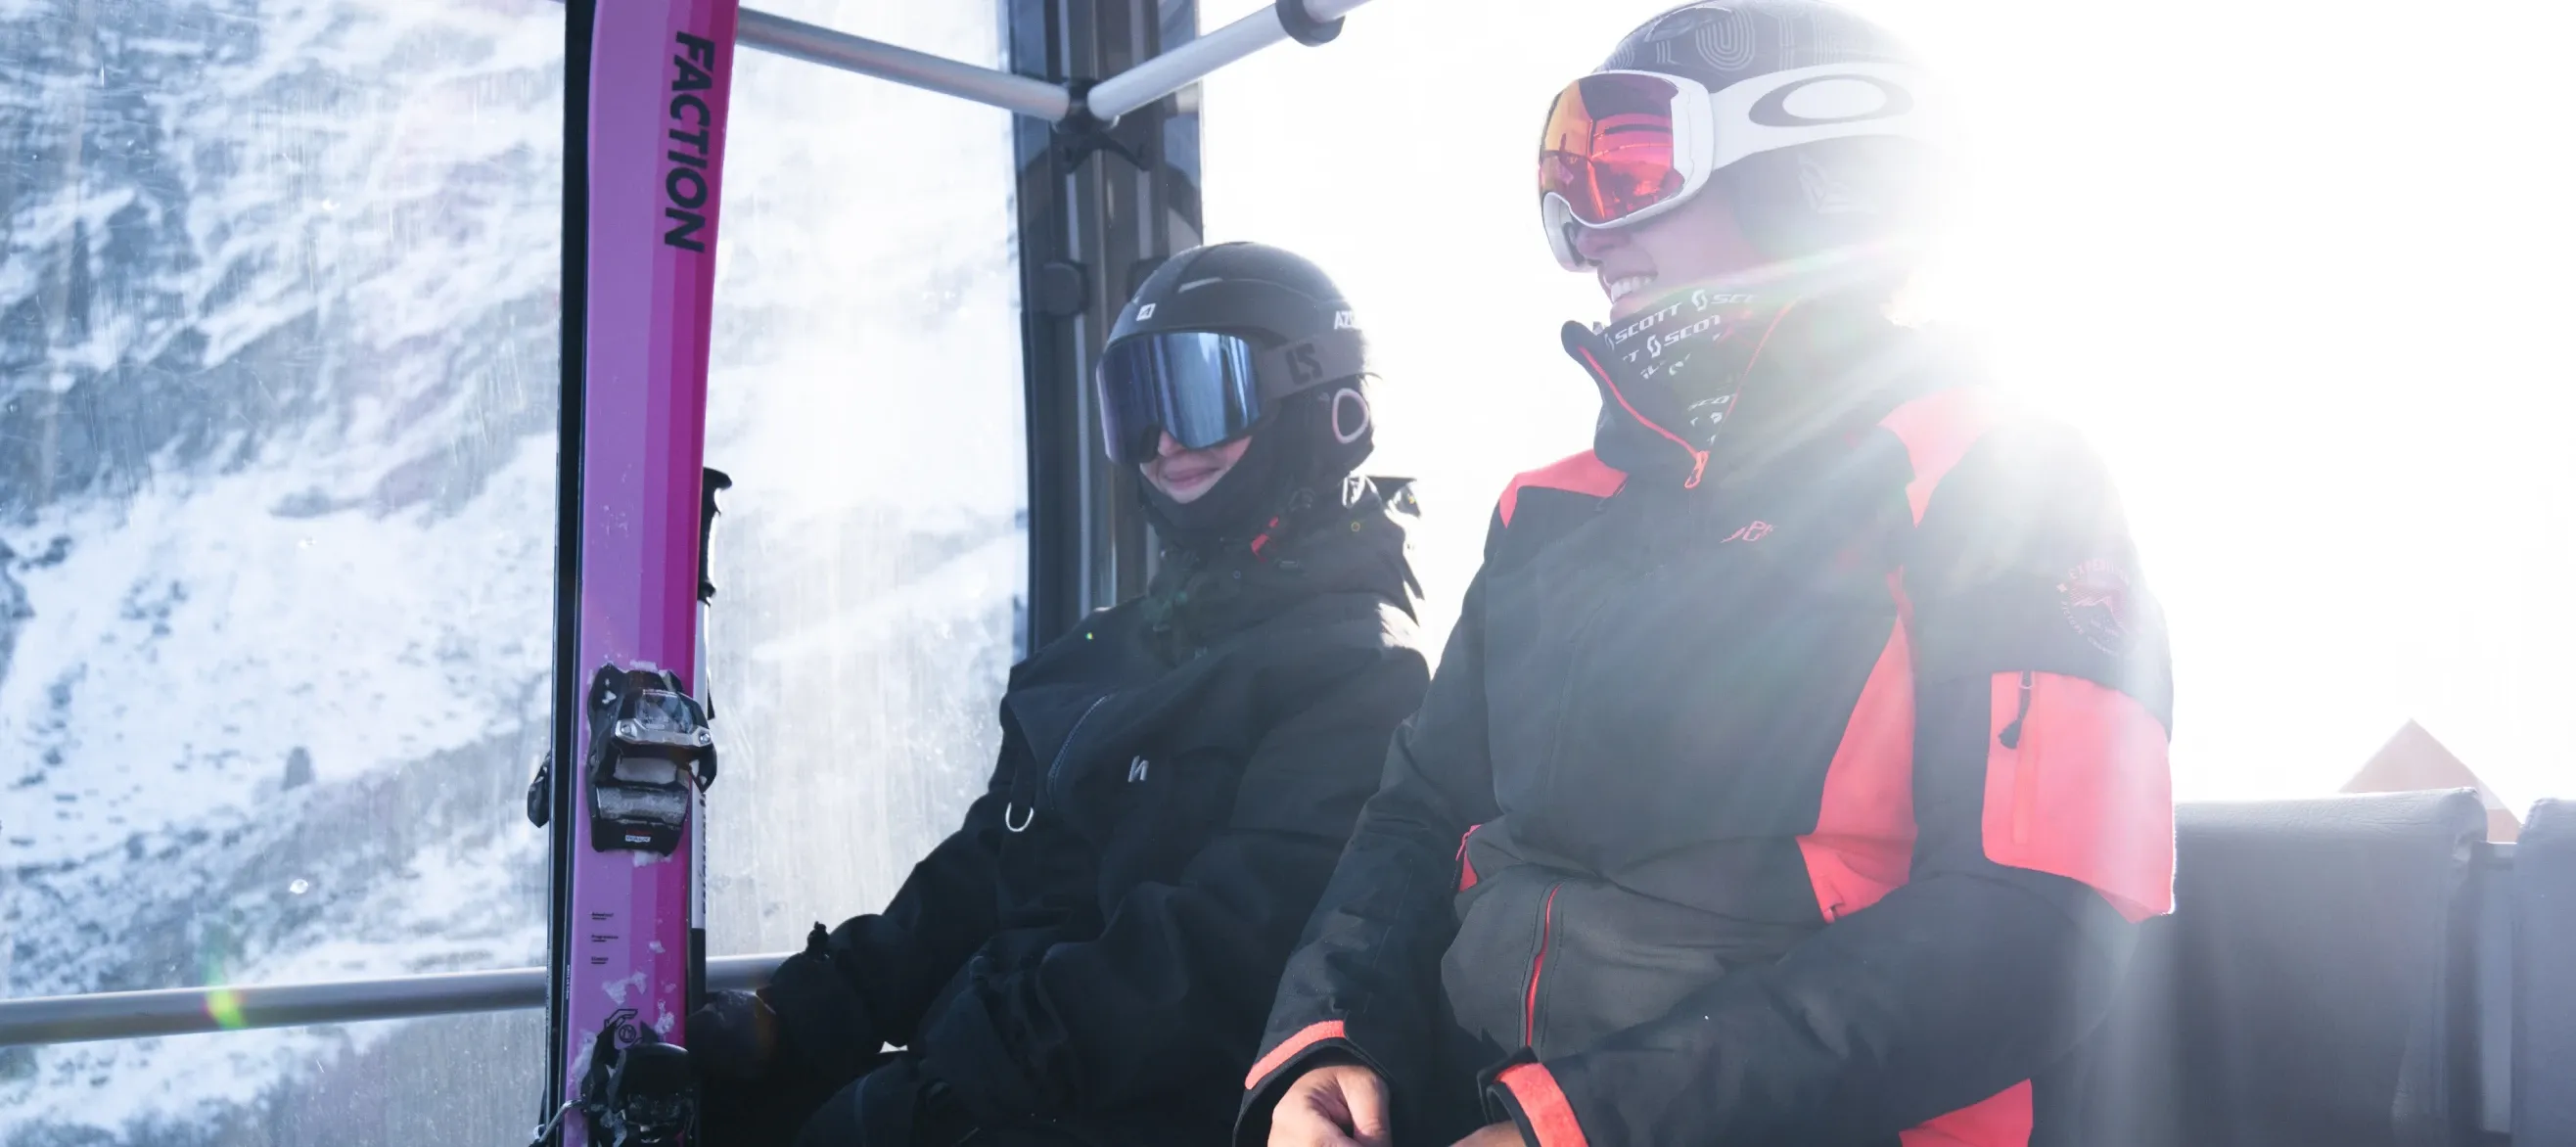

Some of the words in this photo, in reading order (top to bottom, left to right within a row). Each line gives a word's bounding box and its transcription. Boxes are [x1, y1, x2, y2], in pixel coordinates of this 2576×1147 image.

[664, 30, 715, 253] FACTION
[1615, 301, 1682, 344] SCOTT
[2067, 557, 2131, 587] EXPEDIN
